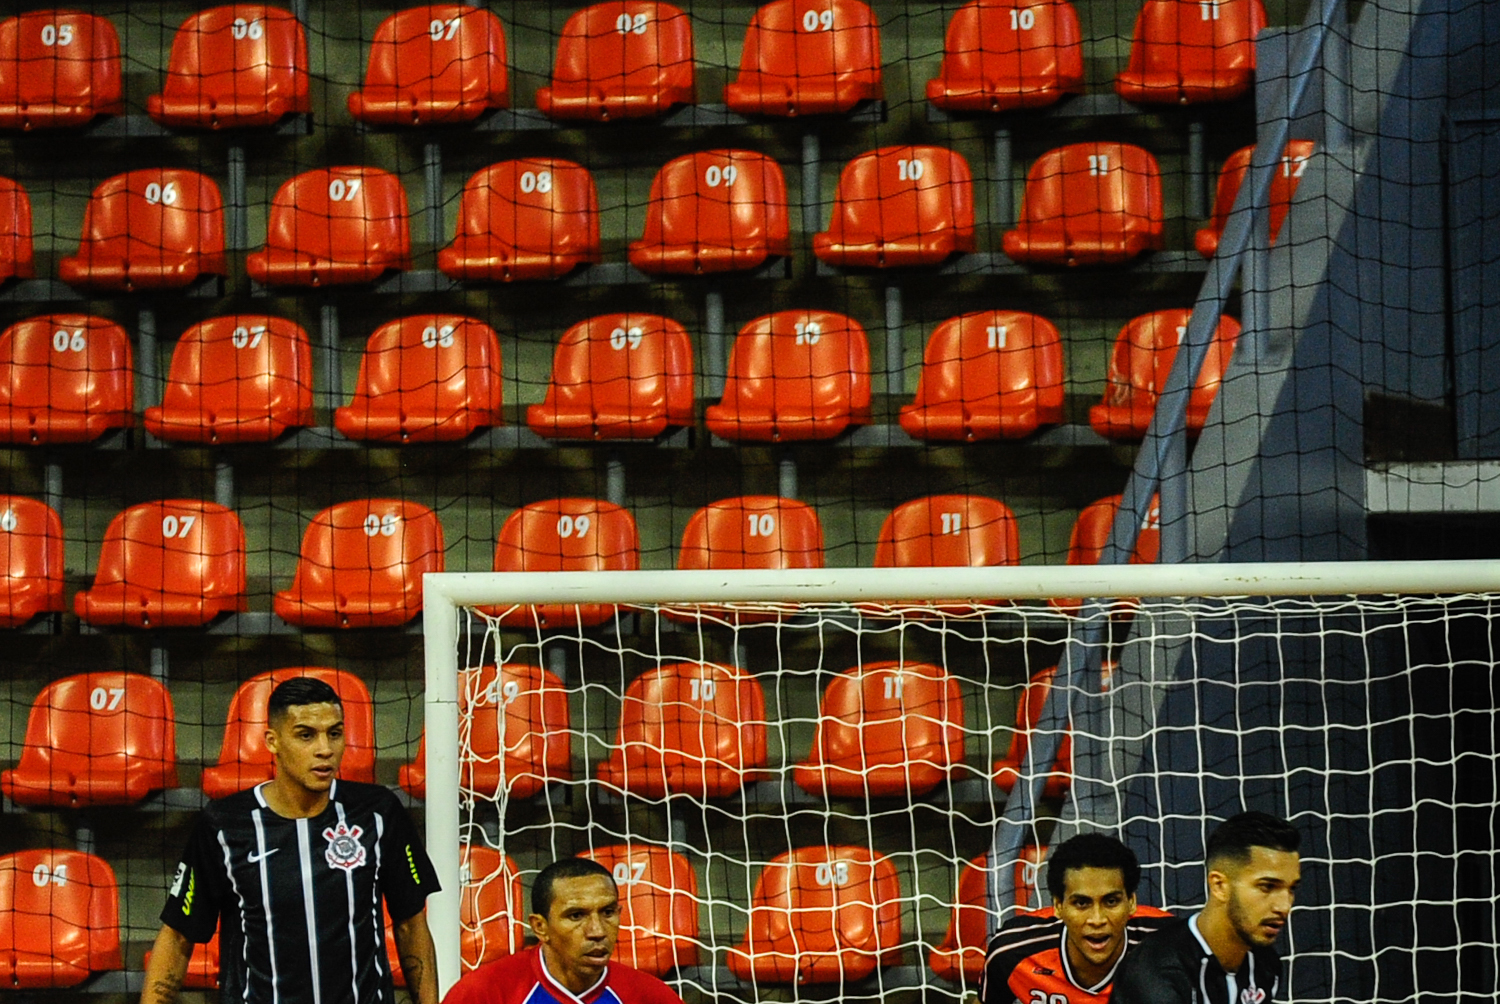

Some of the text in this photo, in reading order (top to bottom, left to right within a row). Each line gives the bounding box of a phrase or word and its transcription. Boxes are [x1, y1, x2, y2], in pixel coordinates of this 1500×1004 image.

[804, 8, 833, 31] 09
[1011, 7, 1033, 29] 10
[1199, 0, 1219, 20] 11
[233, 19, 262, 39] 06
[431, 19, 460, 40] 07
[617, 14, 648, 34] 08
[42, 26, 73, 45] 05
[706, 166, 737, 186] 09
[898, 160, 922, 180] 10
[1089, 155, 1107, 175] 11
[330, 179, 362, 203] 07
[521, 172, 551, 193] 08
[146, 183, 178, 206] 06
[54, 330, 85, 351] 06
[233, 326, 265, 348] 07
[423, 325, 454, 348] 08
[611, 327, 642, 349] 09
[795, 322, 820, 344] 10
[987, 326, 1007, 348] 11
[163, 516, 194, 539] 07
[364, 514, 396, 536] 08
[558, 516, 589, 537] 09
[749, 514, 775, 536] 10
[942, 514, 960, 534] 11
[688, 680, 716, 702] 10
[884, 677, 902, 698] 11
[91, 688, 124, 710] 07
[33, 864, 67, 886] 04
[613, 863, 645, 885] 07
